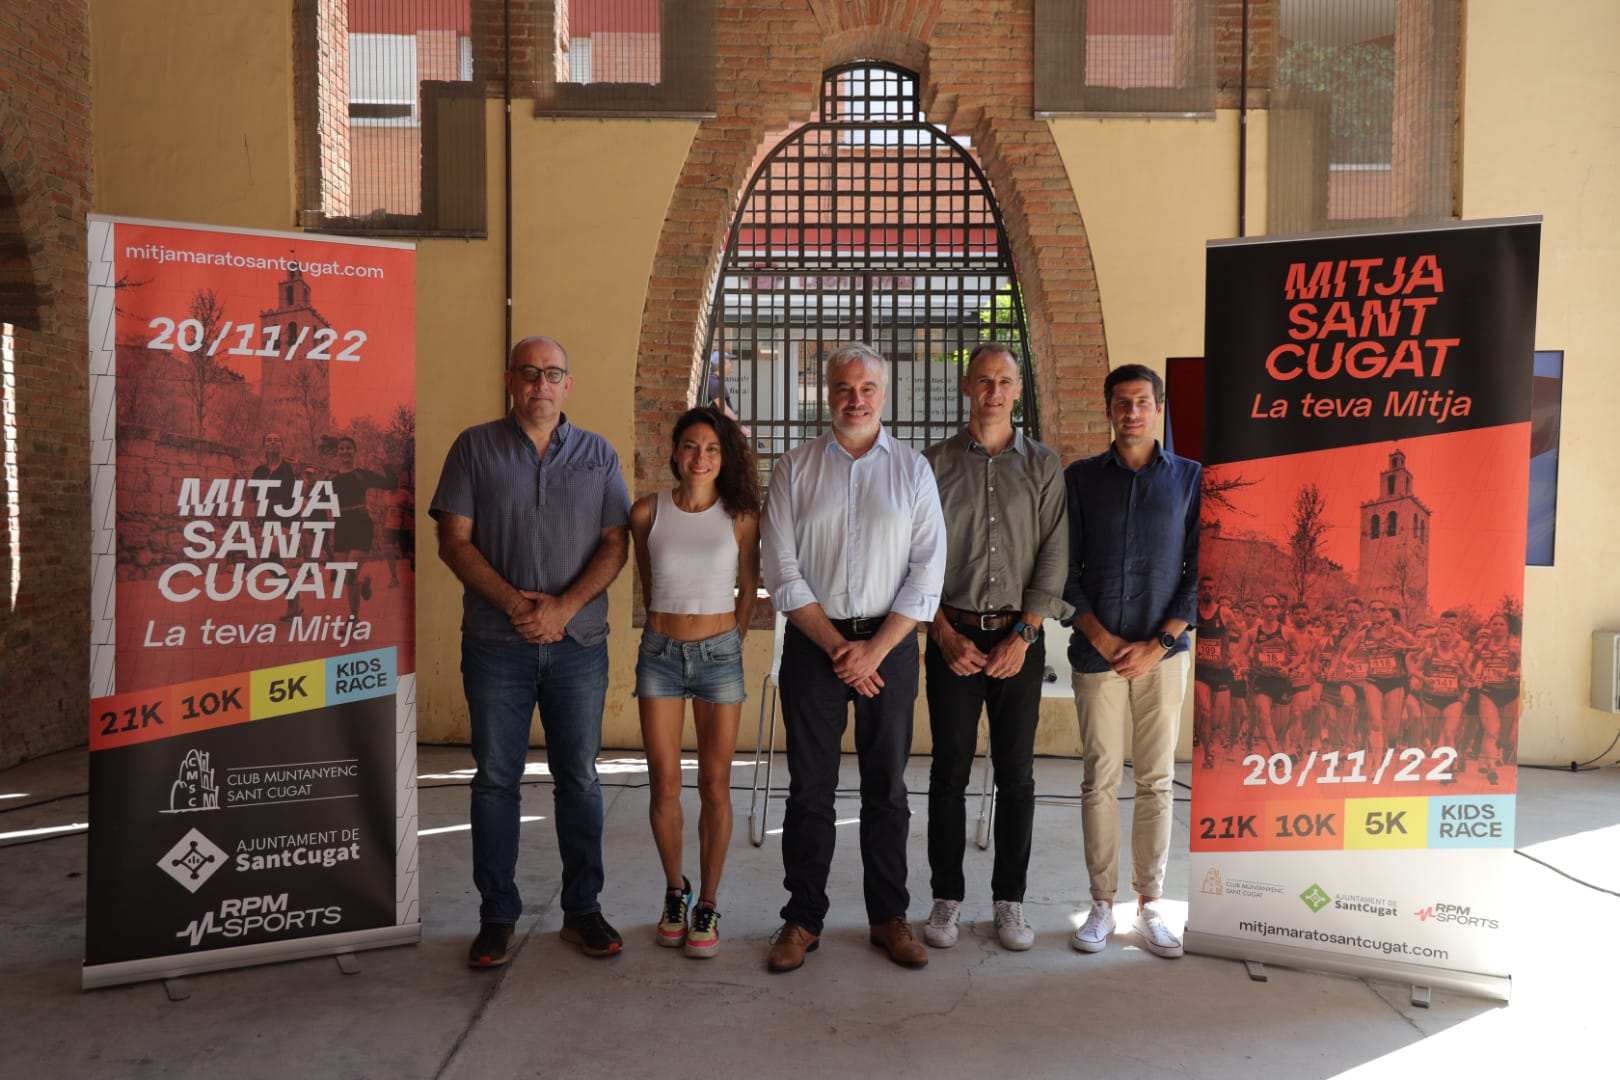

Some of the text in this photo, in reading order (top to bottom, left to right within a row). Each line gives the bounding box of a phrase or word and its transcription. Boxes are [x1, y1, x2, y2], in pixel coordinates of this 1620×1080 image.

[125, 244, 384, 280] mitjamaratosantcugat.com
[1284, 255, 1444, 300] MITJA
[1288, 297, 1438, 341] SANT
[147, 316, 367, 362] 20/11/22
[1265, 338, 1460, 381] CUGAT
[1251, 390, 1472, 424] La teva Mitja
[177, 477, 341, 518] MITJA
[182, 520, 336, 560] SANT
[158, 561, 358, 602] CUGAT
[143, 614, 372, 648] La teva Mitja
[335, 672, 388, 696] RACE
[336, 657, 382, 679] KIDS
[100, 675, 309, 736] 21K 10K 5K
[226, 765, 359, 787] CLUB MUNTANYENC
[1242, 746, 1458, 788] 20/11/22
[226, 784, 313, 803] SANT CUGAT
[1199, 811, 1408, 840] 21K 10K 5K
[1441, 804, 1496, 821] KIDS
[236, 828, 360, 853] AJUNTAMENT DE
[1439, 821, 1502, 839] RACE
[235, 842, 361, 872] SantCugat
[219, 893, 289, 920] RPM
[1334, 893, 1398, 907] AJUNTAMENT DE
[1334, 900, 1398, 917] SantCugat
[1435, 903, 1471, 916] RPM
[221, 905, 343, 939] SPORTS
[1436, 912, 1500, 930] SPORTS
[1239, 919, 1449, 960] mitjamaratosantcugat.com
